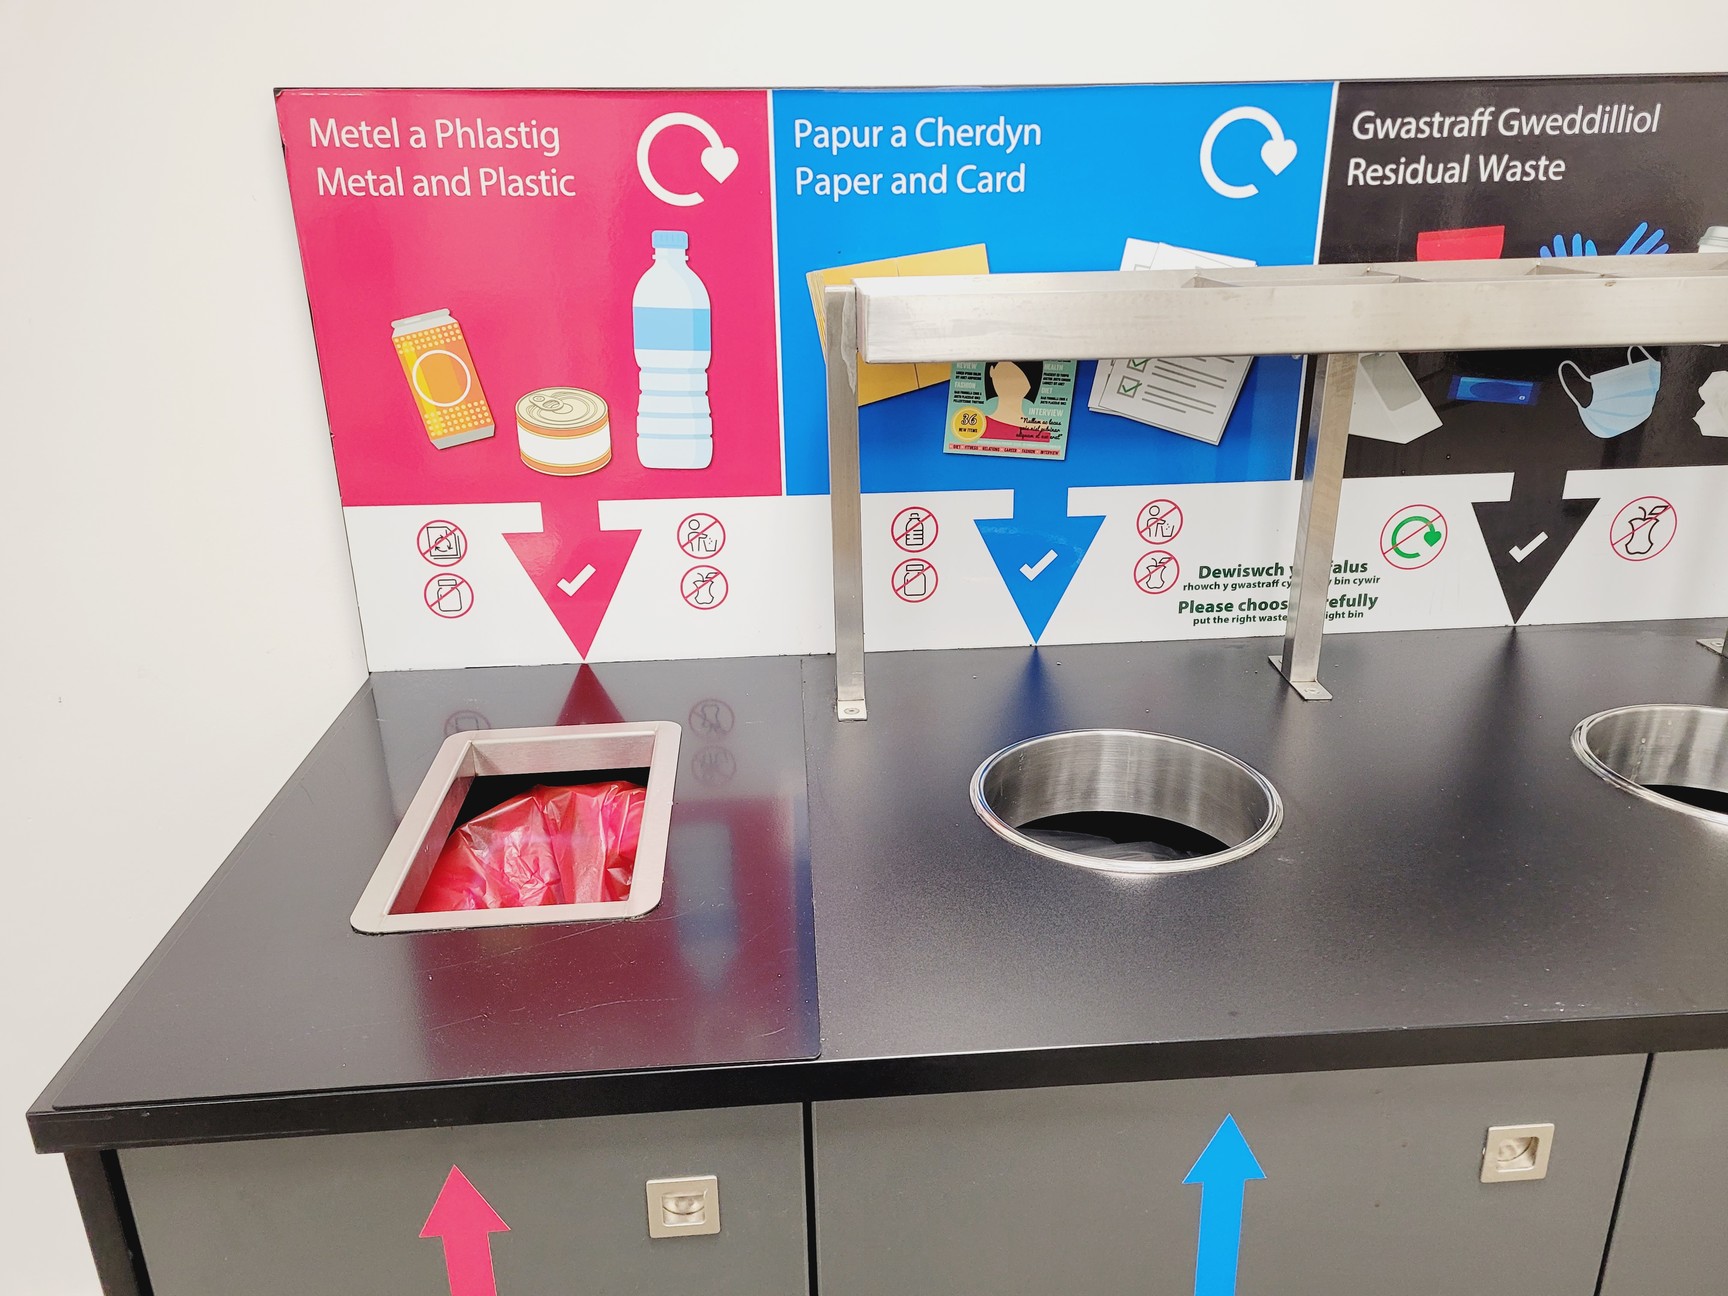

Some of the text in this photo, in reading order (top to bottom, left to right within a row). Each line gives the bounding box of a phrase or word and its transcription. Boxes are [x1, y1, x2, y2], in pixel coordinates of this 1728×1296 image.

[1352, 103, 1662, 140] Gwastraff Gweddilliol
[309, 117, 560, 157] Metel a Phlastig
[794, 116, 1041, 155] Papur a Cherdyn
[317, 166, 576, 197] Metal and Plastic
[1347, 153, 1566, 186] Residual Waste
[795, 163, 1026, 203] Paper and Card
[960, 412, 978, 426] 36
[1028, 407, 1064, 417] INTERVIEW
[1199, 562, 1284, 579] Dewiswch
[1331, 560, 1368, 574] alus
[1183, 581, 1221, 591] rhowch
[1222, 583, 1229, 592] y
[1231, 579, 1280, 592] gwastraff
[1334, 577, 1350, 585] bin
[1352, 575, 1380, 587] cywir
[1178, 593, 1379, 614] Please choos efully
[1193, 610, 1364, 627] put the right waste ight bin
